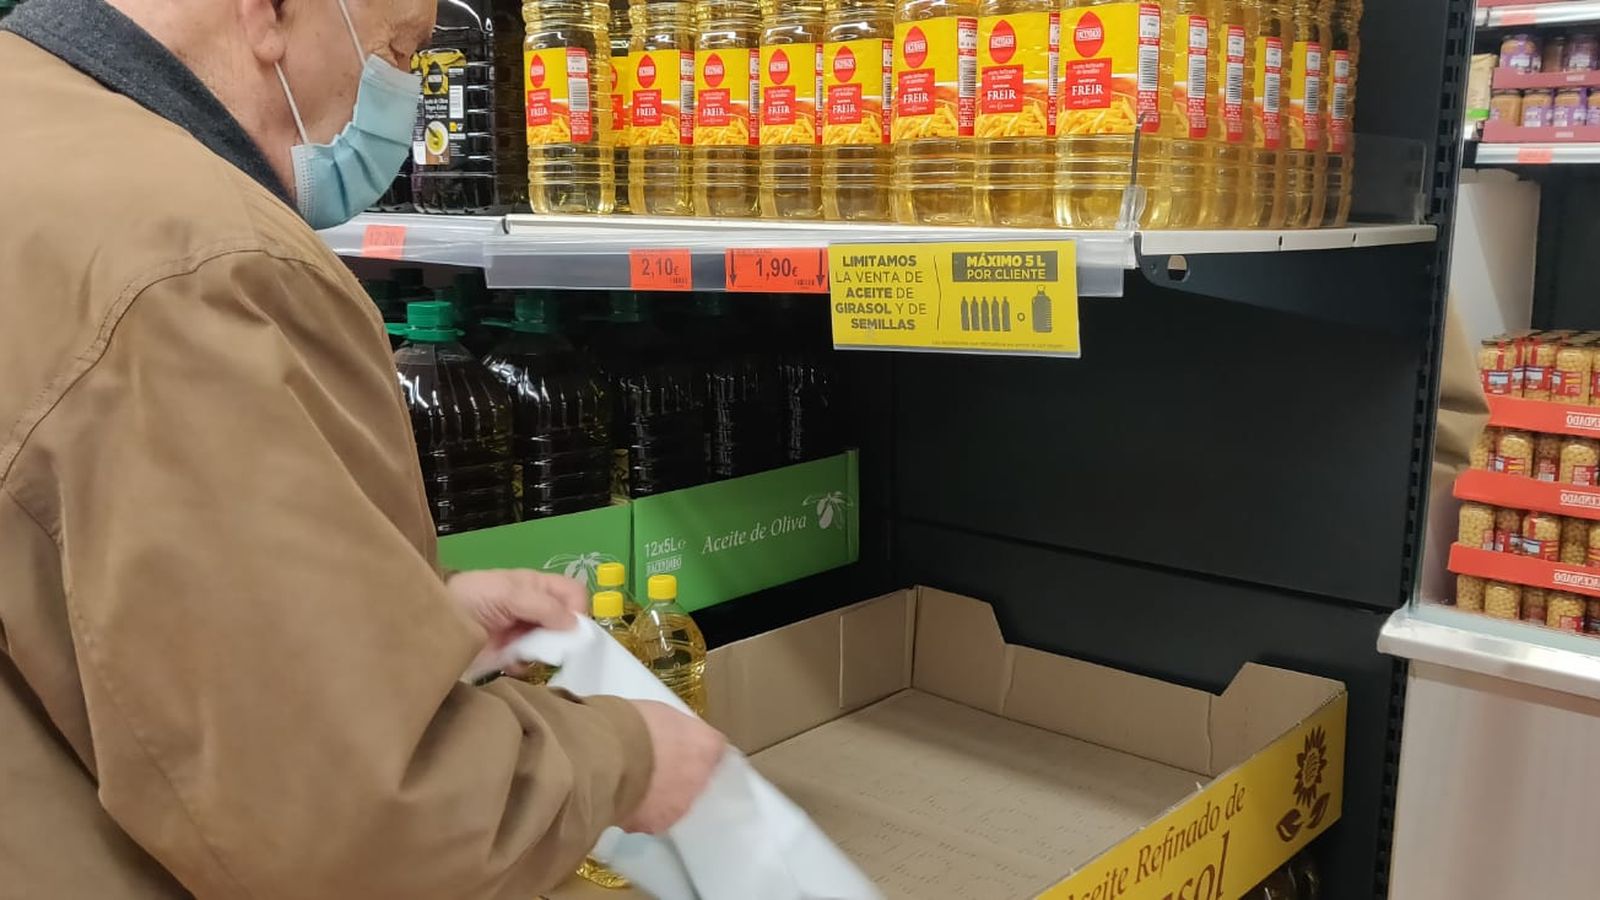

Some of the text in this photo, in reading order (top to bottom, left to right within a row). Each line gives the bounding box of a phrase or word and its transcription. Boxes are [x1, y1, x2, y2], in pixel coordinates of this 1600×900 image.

[842, 255, 917, 267] LIMITAMOS
[966, 253, 1046, 268] MÁXIMO 5 L
[641, 257, 681, 280] 2,10€
[756, 257, 799, 281] 1,90€
[967, 269, 1046, 280] POR CLIENTE
[835, 271, 923, 282] LA VENTA DE
[845, 287, 914, 299] ACEITE DE
[835, 302, 926, 315] GIRASOL Y DE
[850, 319, 916, 330] SEMILLAS
[702, 514, 807, 554] Aceite de Oliva
[1135, 800, 1221, 884] Refinado
[1225, 782, 1246, 820] de
